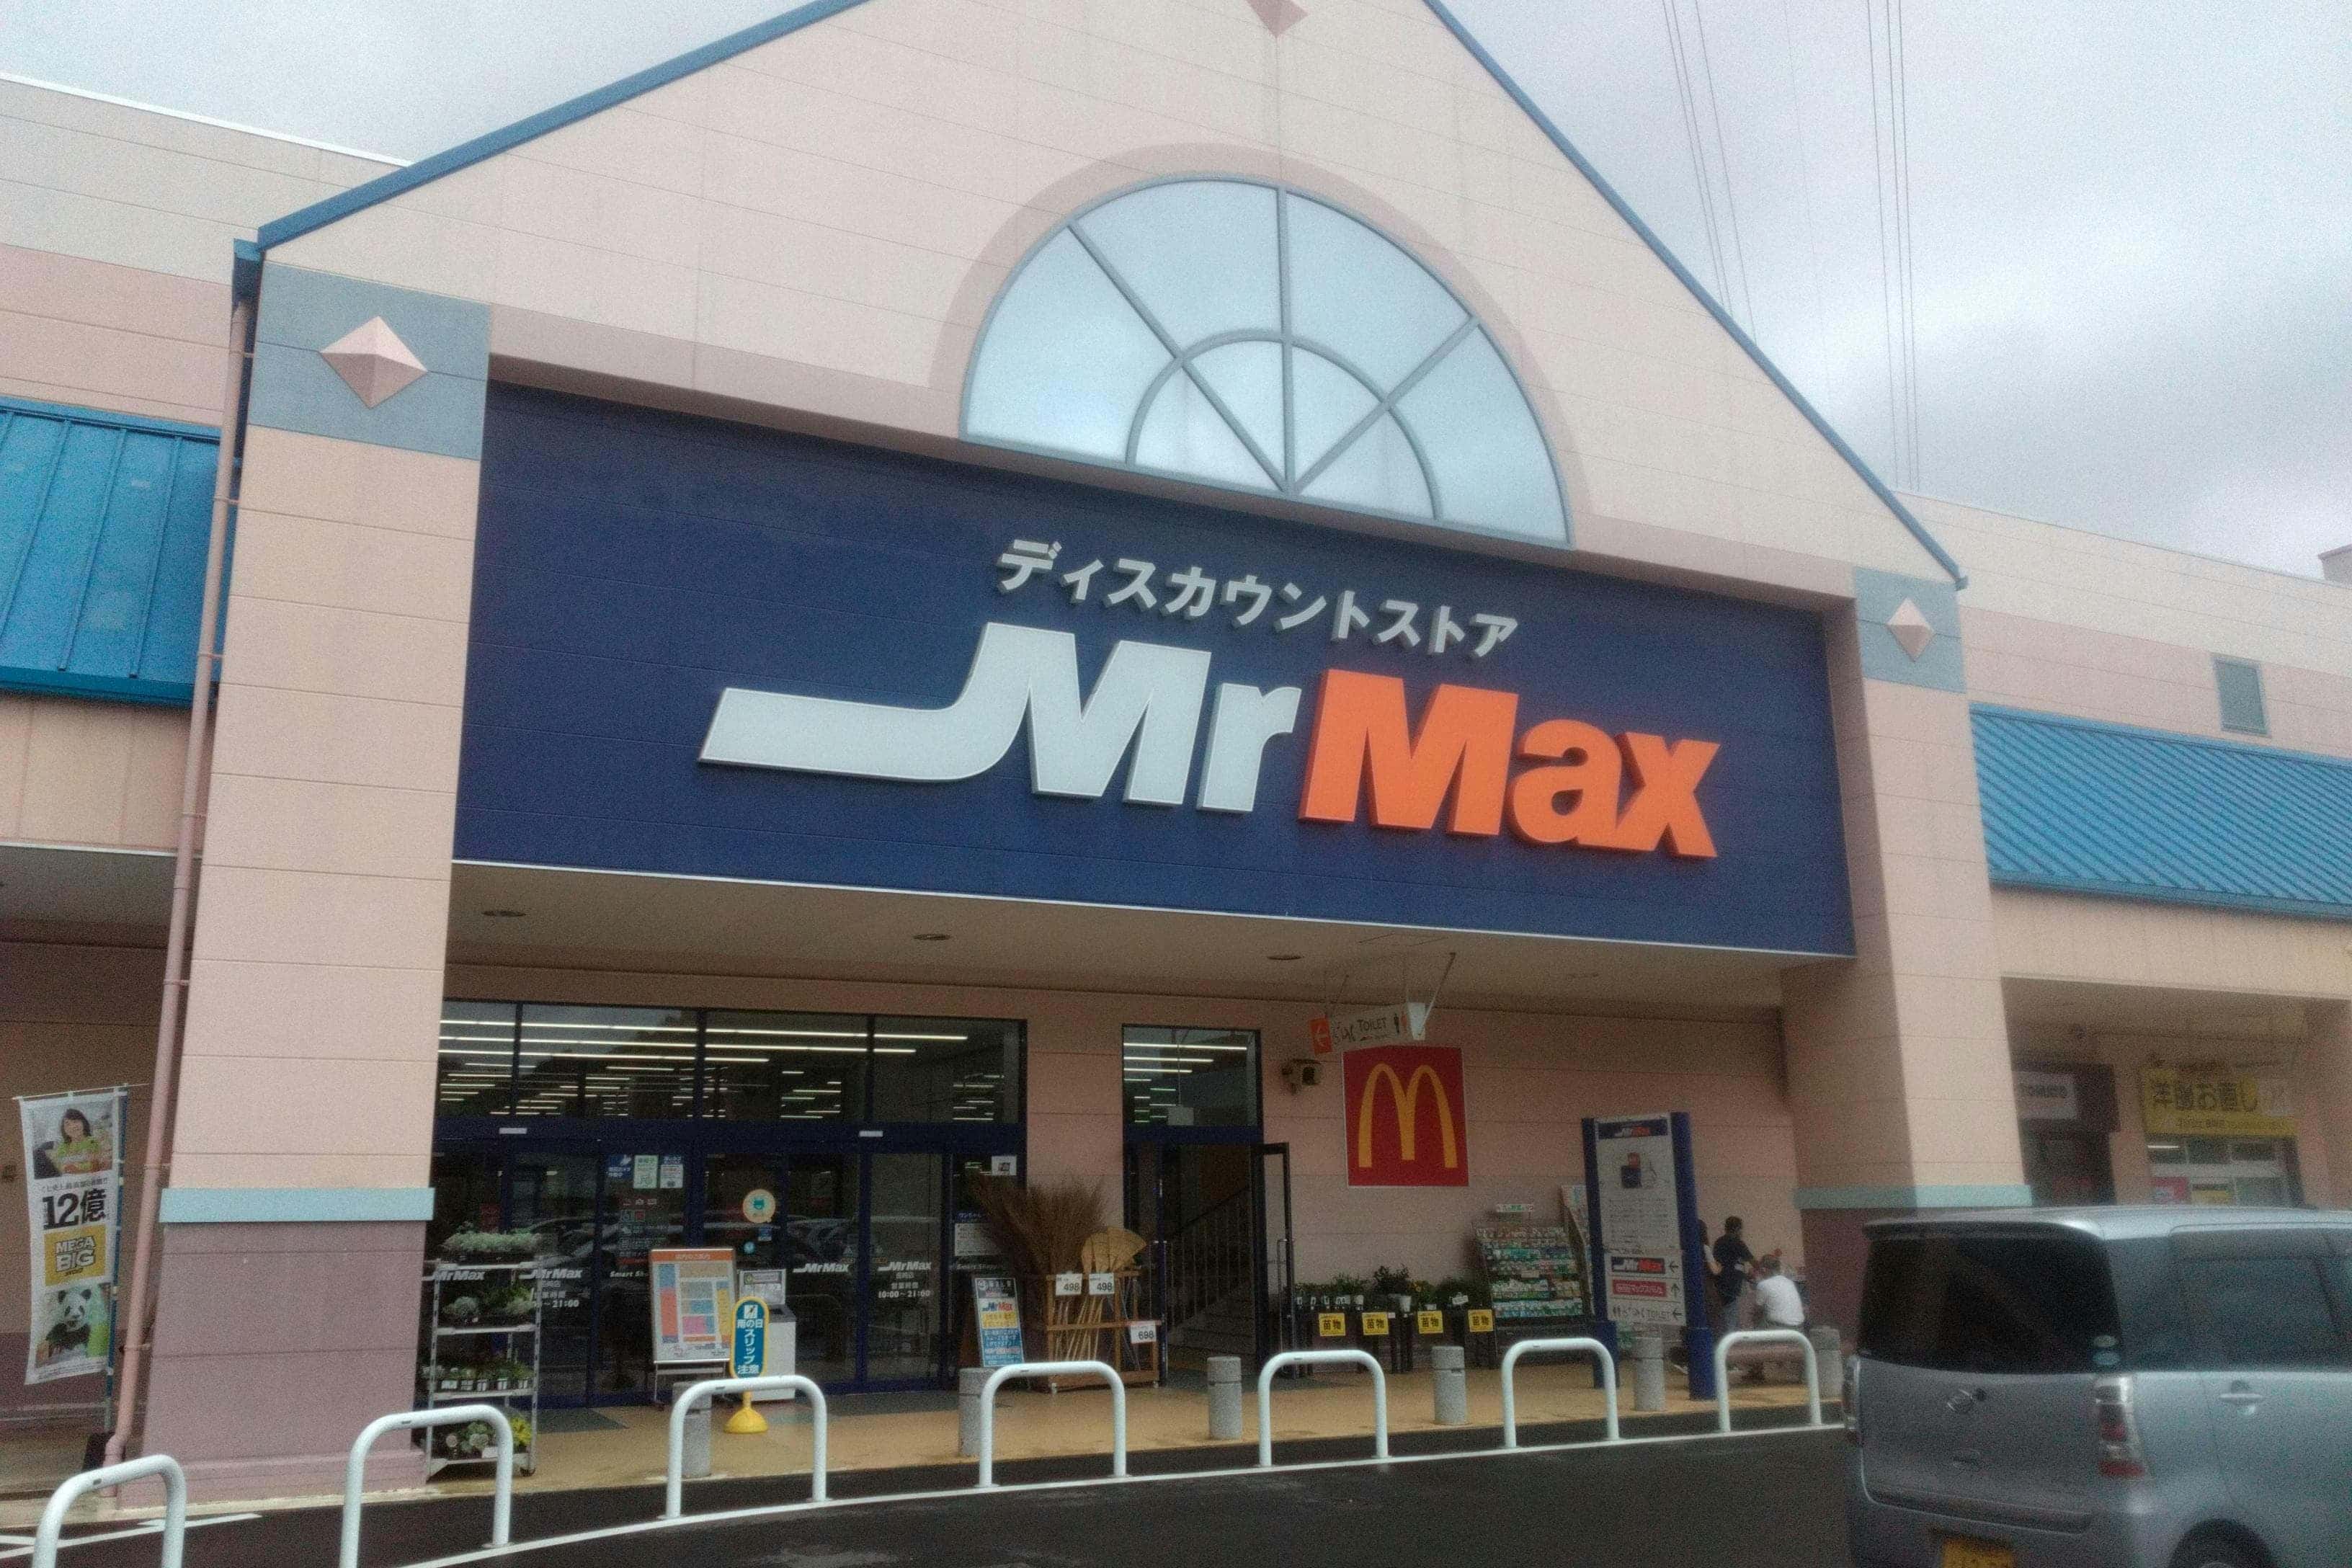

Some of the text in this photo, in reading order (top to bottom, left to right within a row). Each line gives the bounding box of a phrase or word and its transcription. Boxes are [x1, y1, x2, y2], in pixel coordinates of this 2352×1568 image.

[998, 538, 1519, 660] ディスカウントストア
[1357, 1017, 1387, 1033] TOILET
[55, 1237, 95, 1254] MEGA
[55, 1250, 96, 1273] BIG
[878, 1261, 932, 1272] MrMax
[793, 1263, 850, 1273] MrMax
[1064, 1282, 1080, 1292] 498
[1097, 1282, 1113, 1293] 498
[738, 1319, 763, 1329] 雨の日
[1324, 1320, 1341, 1330] 苗物
[1366, 1319, 1384, 1329] 苗物
[1422, 1317, 1439, 1327] 苗物
[1473, 1315, 1489, 1325] 苗物
[744, 1329, 756, 1364] スリップ
[738, 1364, 760, 1375] 注意
